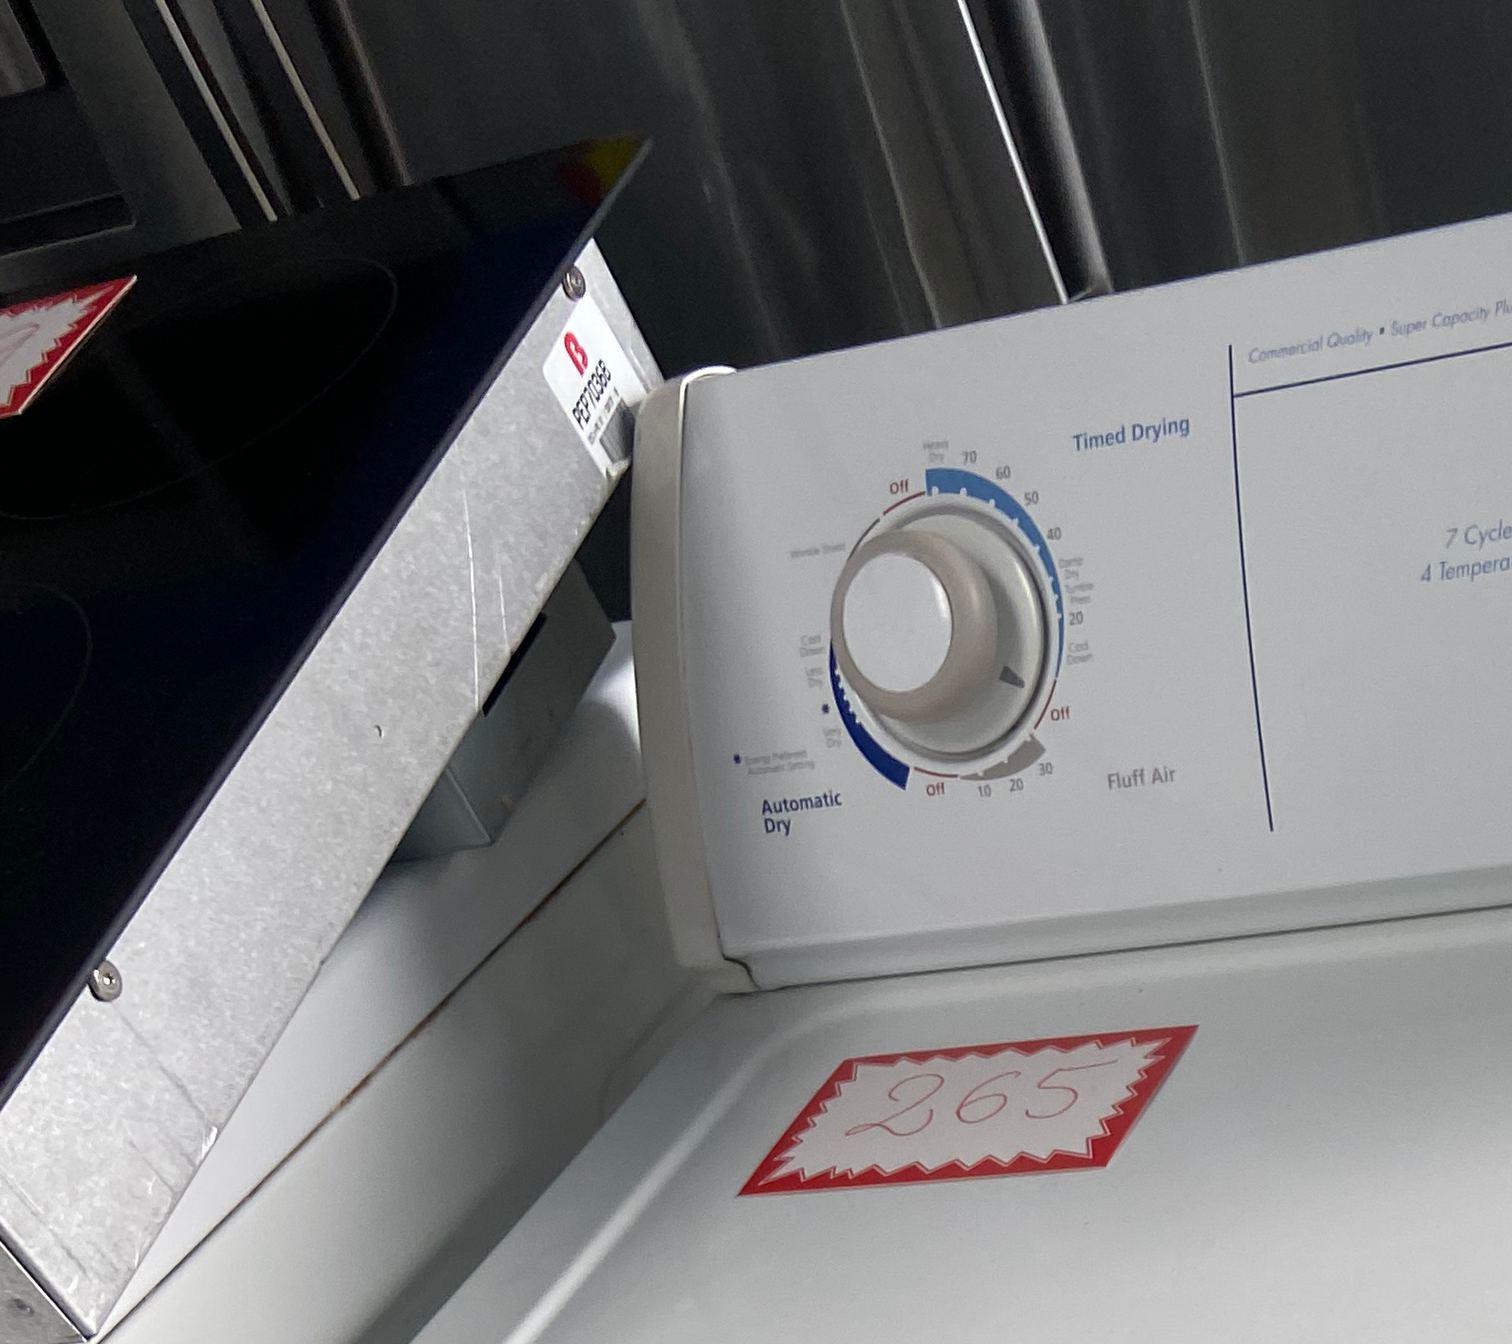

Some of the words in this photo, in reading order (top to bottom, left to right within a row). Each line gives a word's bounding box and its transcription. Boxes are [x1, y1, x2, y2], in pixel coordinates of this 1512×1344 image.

[1248, 336, 1324, 364] Commercial
[1327, 329, 1373, 348] Quality
[1390, 320, 1427, 338] Super
[1432, 306, 1491, 328] Capacity
[572, 359, 611, 430] PEP70368
[1072, 425, 1126, 452] Timed
[1132, 417, 1190, 443] Drying
[962, 450, 978, 465] 70
[995, 465, 1011, 481] 60
[889, 478, 909, 495] Off
[1024, 491, 1039, 507] 50
[1046, 527, 1062, 541] 40
[1446, 527, 1459, 549] 7
[1420, 563, 1432, 582] 4
[1069, 611, 1084, 626] 20
[1050, 706, 1070, 722] Off
[1038, 762, 1054, 776] 30
[1009, 778, 1024, 793] 20
[1107, 767, 1145, 791] Fluff
[1151, 765, 1176, 785] Air
[926, 782, 945, 797] Off
[977, 785, 992, 798] 10
[761, 788, 843, 816] Automatic
[764, 818, 792, 837] Dry
[844, 1058, 1119, 1138] 265
